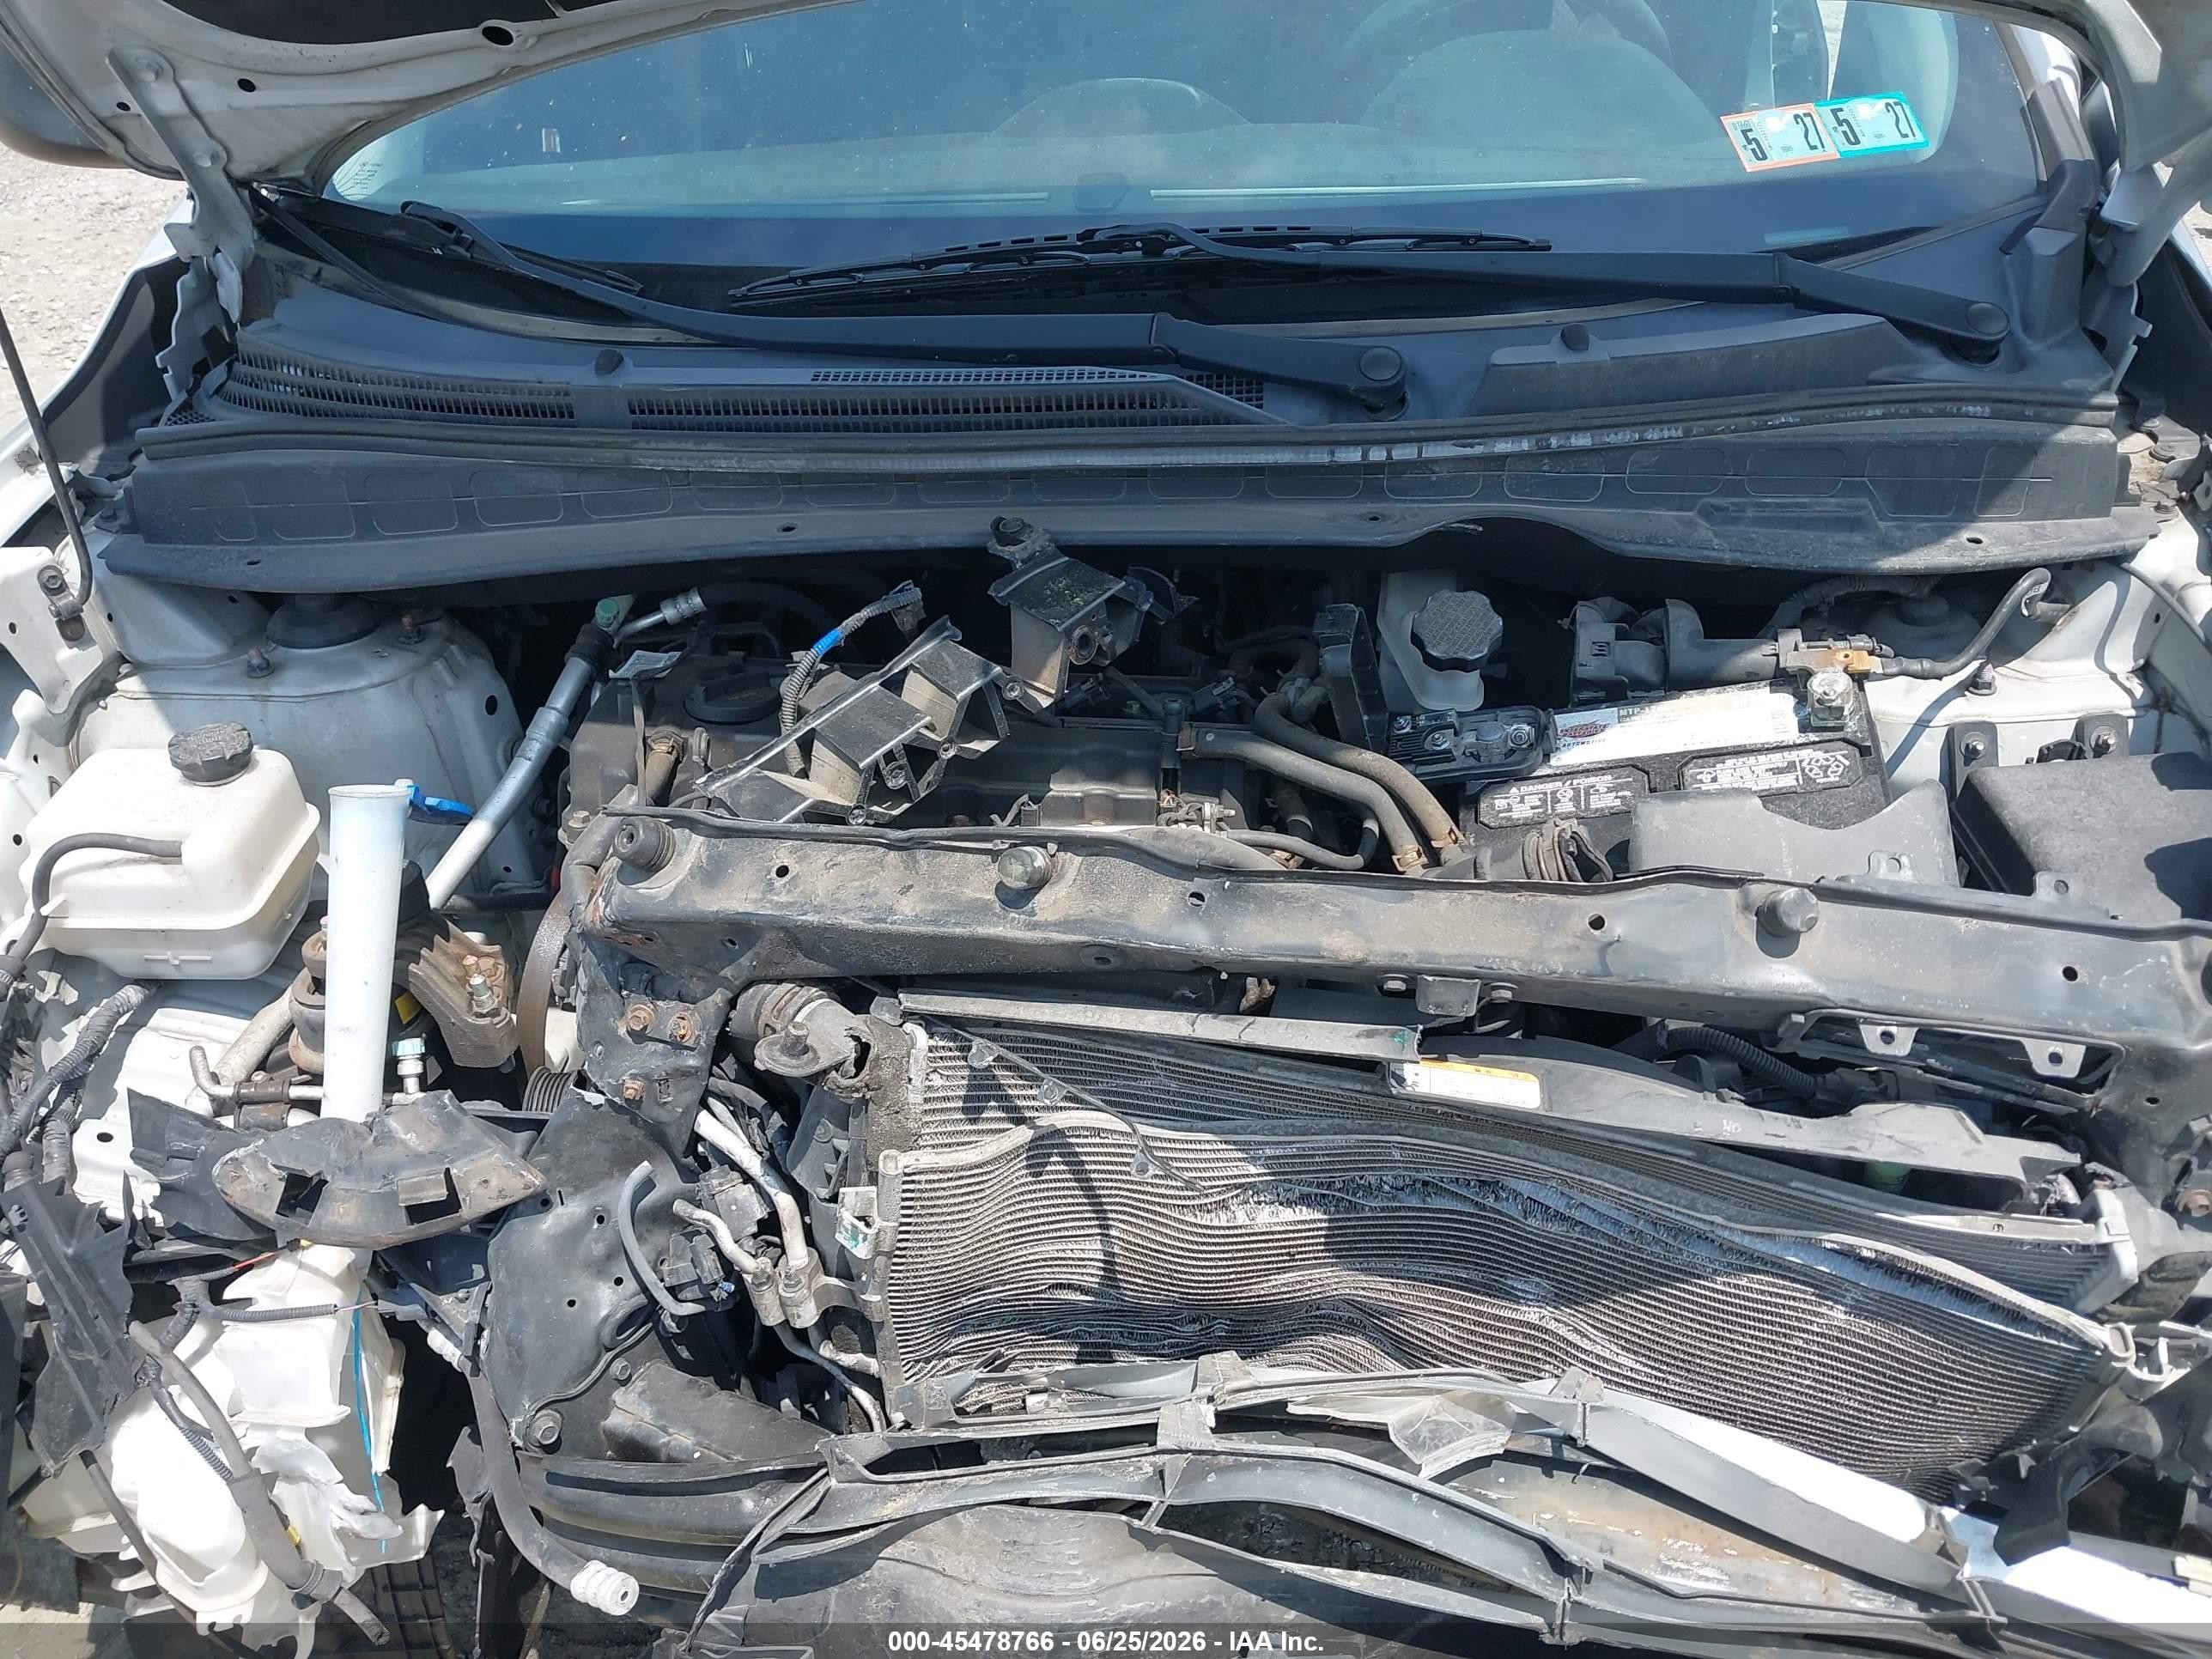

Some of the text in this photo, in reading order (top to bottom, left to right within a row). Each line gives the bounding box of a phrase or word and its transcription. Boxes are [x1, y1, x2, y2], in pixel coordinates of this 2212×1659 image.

[1741, 128, 1768, 161] 5
[1793, 112, 1825, 150] 27
[1830, 107, 1861, 145] 5
[1885, 101, 1916, 138] 27
[1562, 738, 1606, 748] AUTOMOTIVE
[1520, 781, 1563, 793] DANGER
[1572, 775, 1613, 786] POISON
